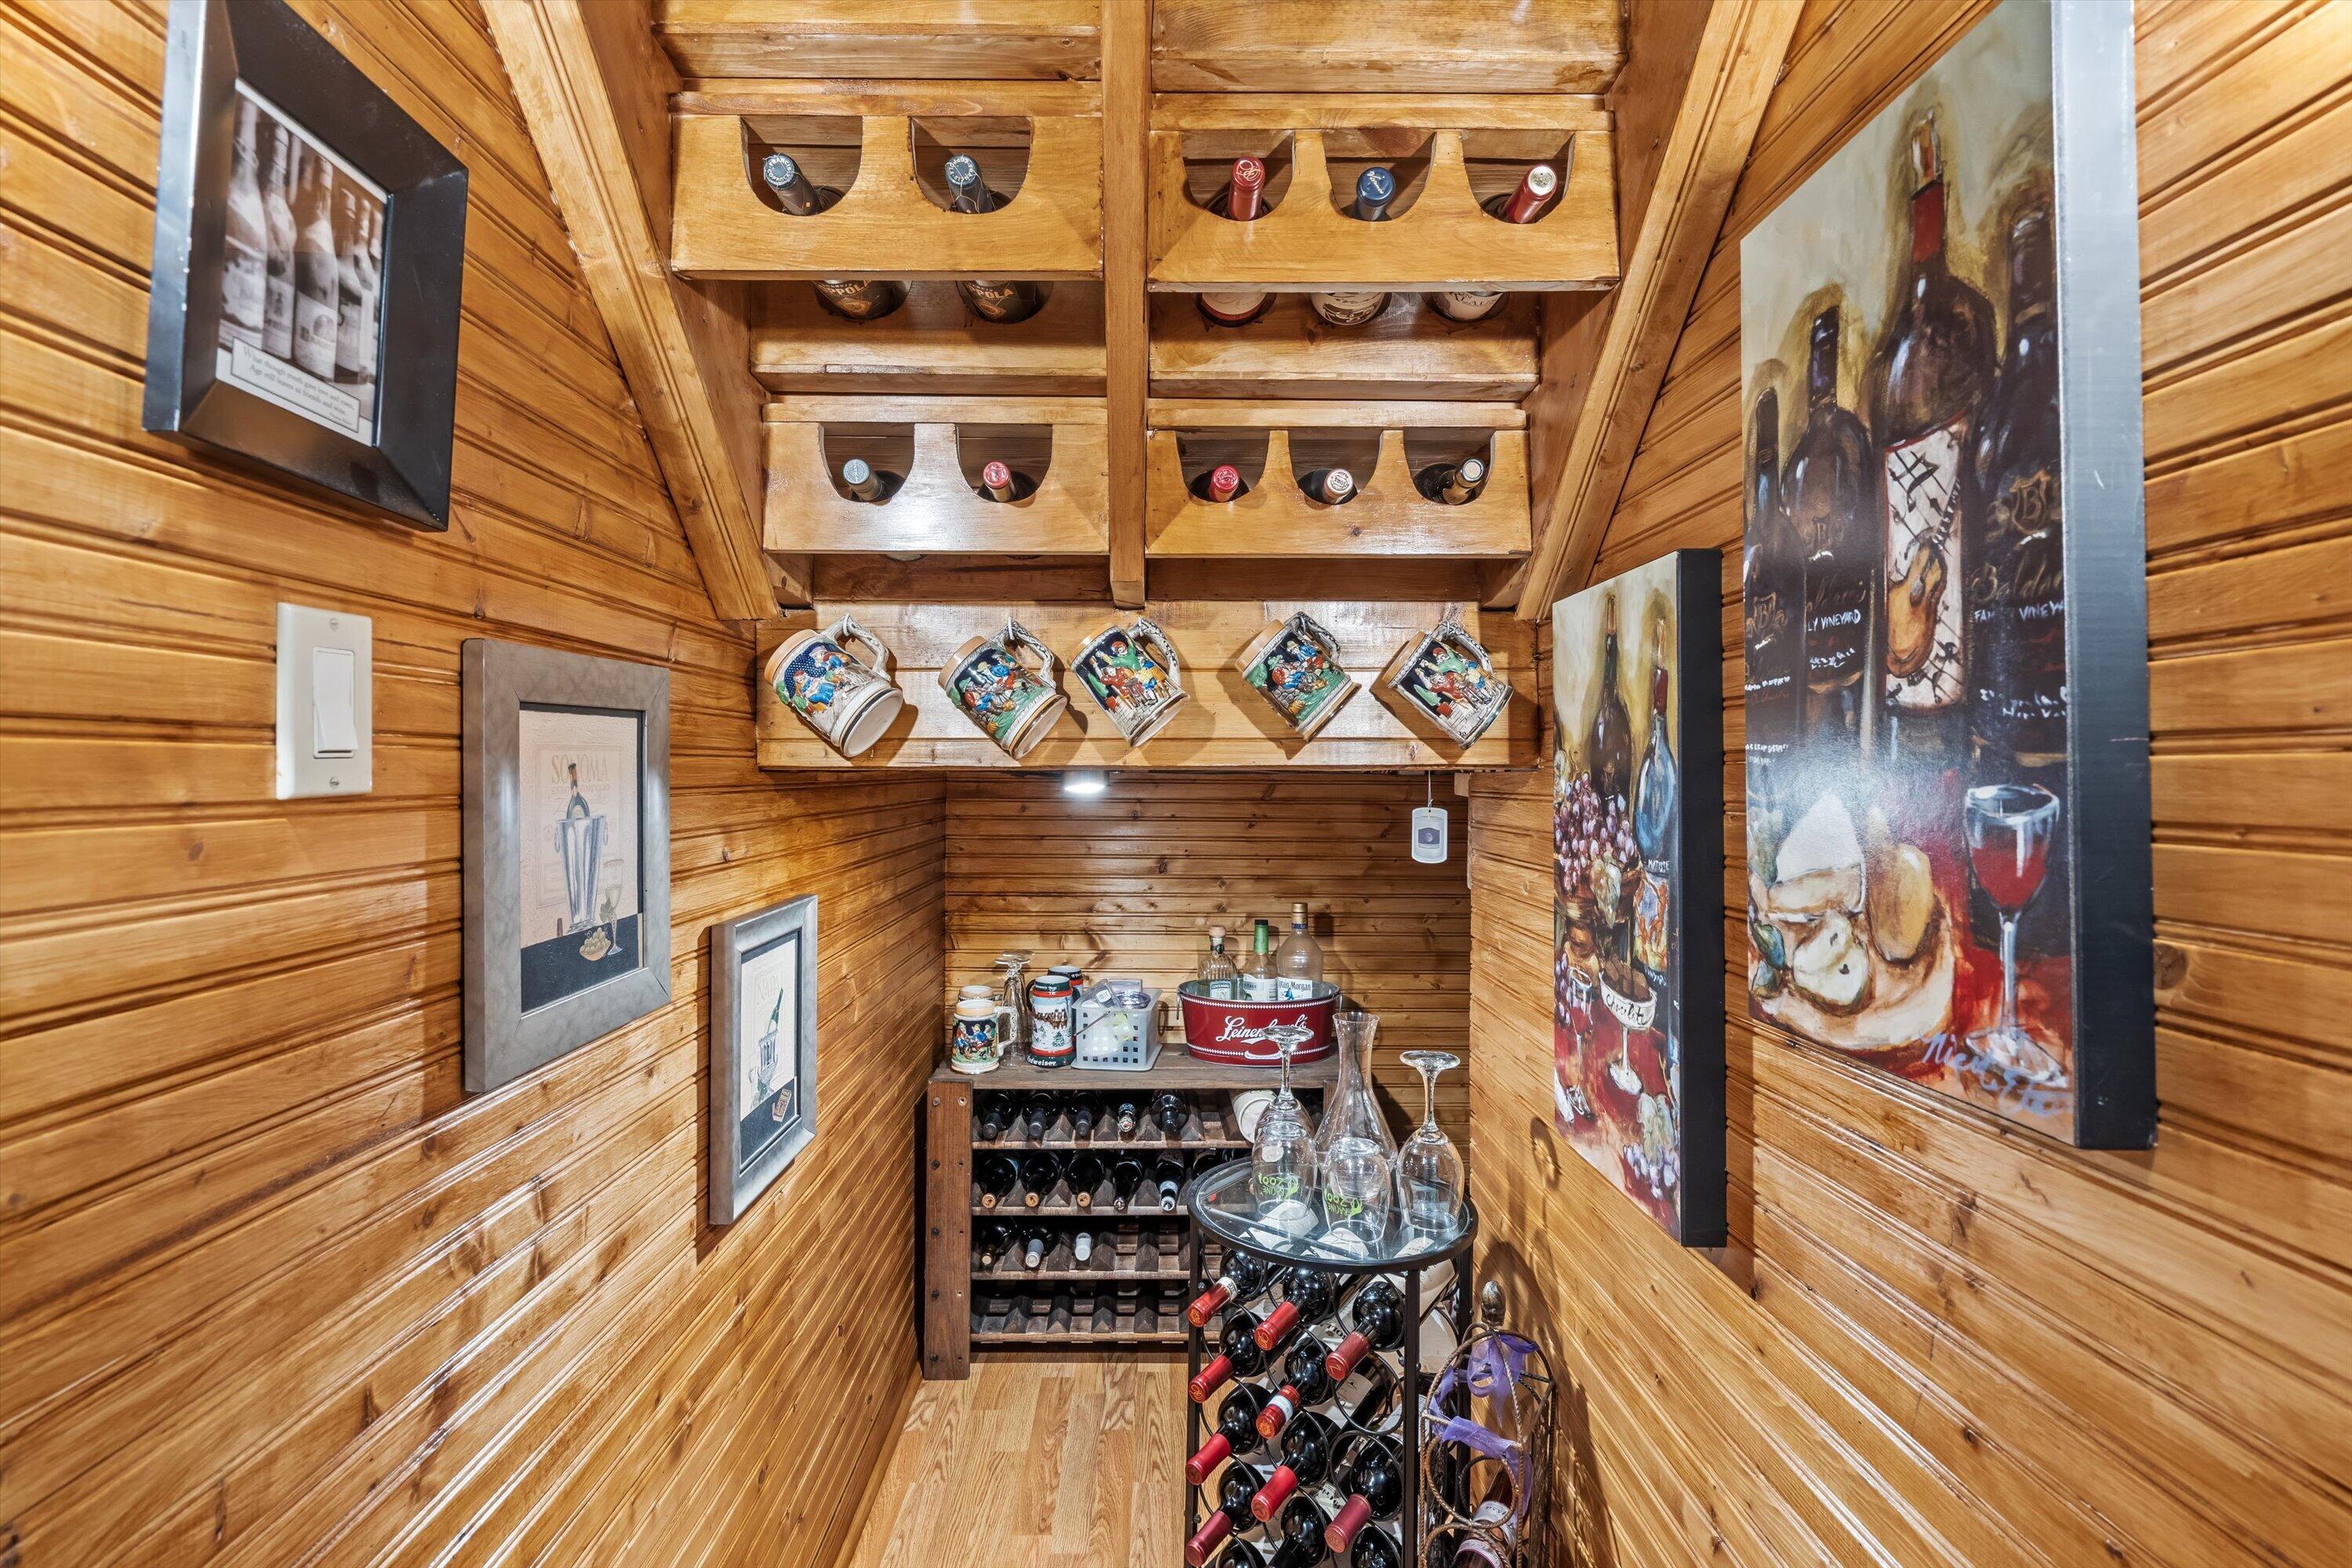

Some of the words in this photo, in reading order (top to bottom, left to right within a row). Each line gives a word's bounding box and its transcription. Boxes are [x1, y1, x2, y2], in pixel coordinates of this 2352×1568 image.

[769, 156, 793, 172] FRANCIS
[1820, 608, 1861, 630] VINEYARD
[1648, 858, 1671, 873] MATISSE
[1290, 981, 1312, 992] Morgan
